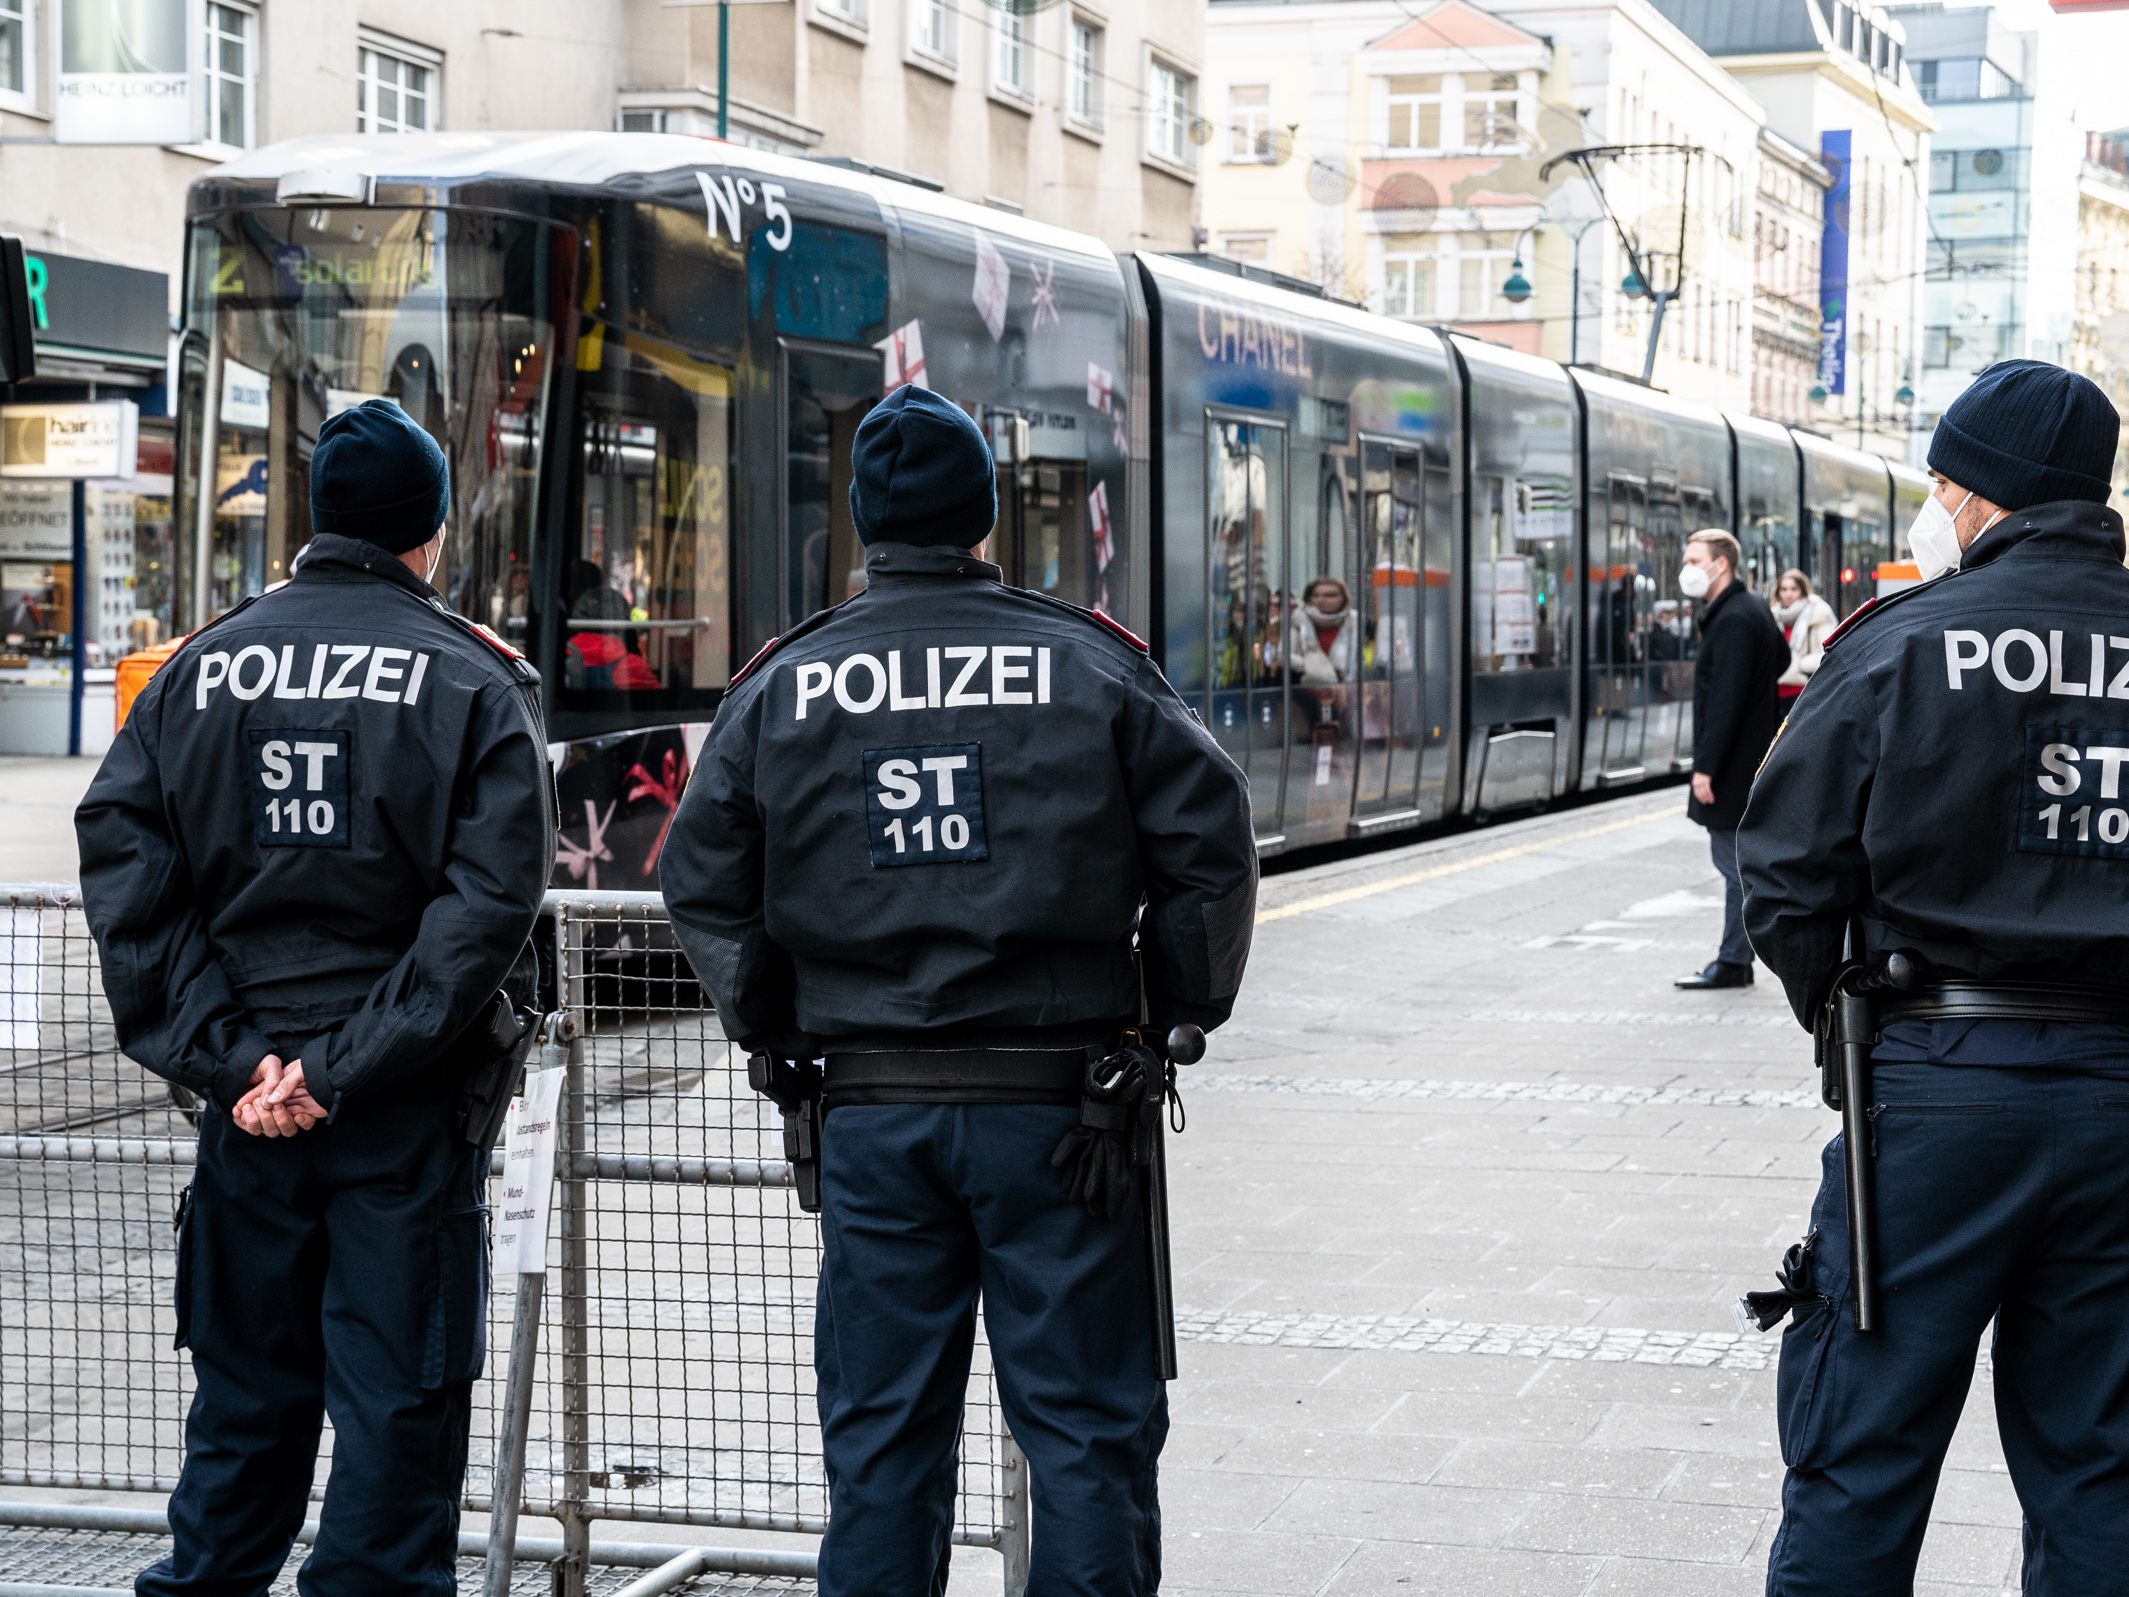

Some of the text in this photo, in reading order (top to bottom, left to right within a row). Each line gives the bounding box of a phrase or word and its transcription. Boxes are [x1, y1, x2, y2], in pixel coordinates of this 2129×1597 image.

[1198, 300, 1313, 379] CHANEL
[195, 644, 429, 710] POLIZEI
[796, 646, 1050, 720] POLIZEI
[261, 740, 338, 791] ST
[877, 755, 967, 810] ST
[2037, 743, 2129, 799] ST
[265, 798, 335, 835] 110
[884, 814, 970, 853] 110
[2038, 803, 2129, 843] 110
